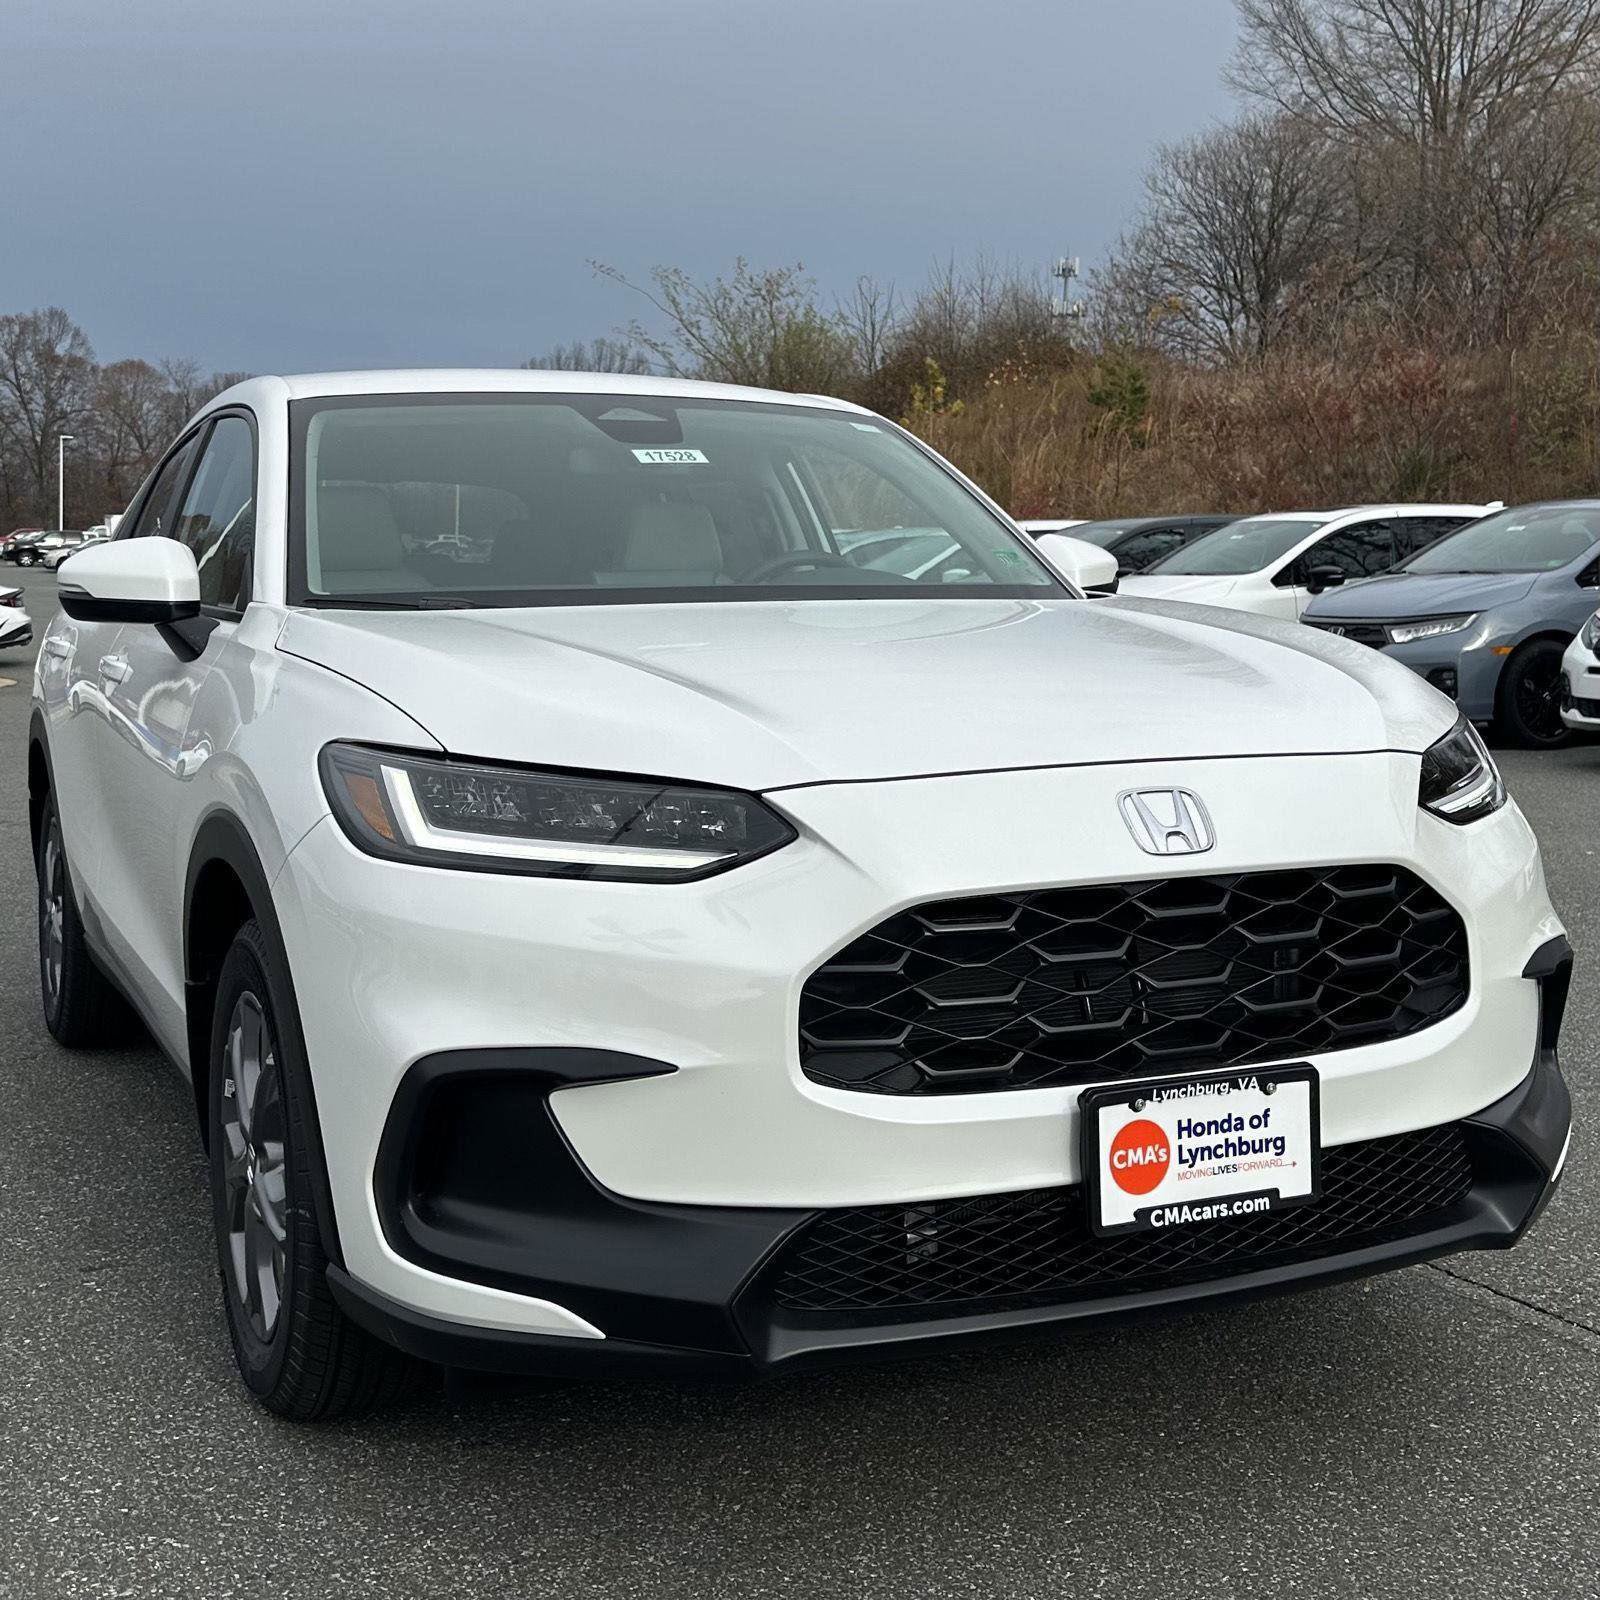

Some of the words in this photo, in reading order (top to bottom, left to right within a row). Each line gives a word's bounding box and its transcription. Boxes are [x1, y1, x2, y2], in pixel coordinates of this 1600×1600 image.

[645, 451, 697, 462] 17528
[1238, 1076, 1260, 1092] VA
[1178, 1113, 1244, 1140] Honda
[1249, 1108, 1271, 1130] of
[1113, 1145, 1168, 1170] CMA's
[1177, 1134, 1286, 1169] Lynchburg
[1150, 1195, 1270, 1228] CMAcars.com
